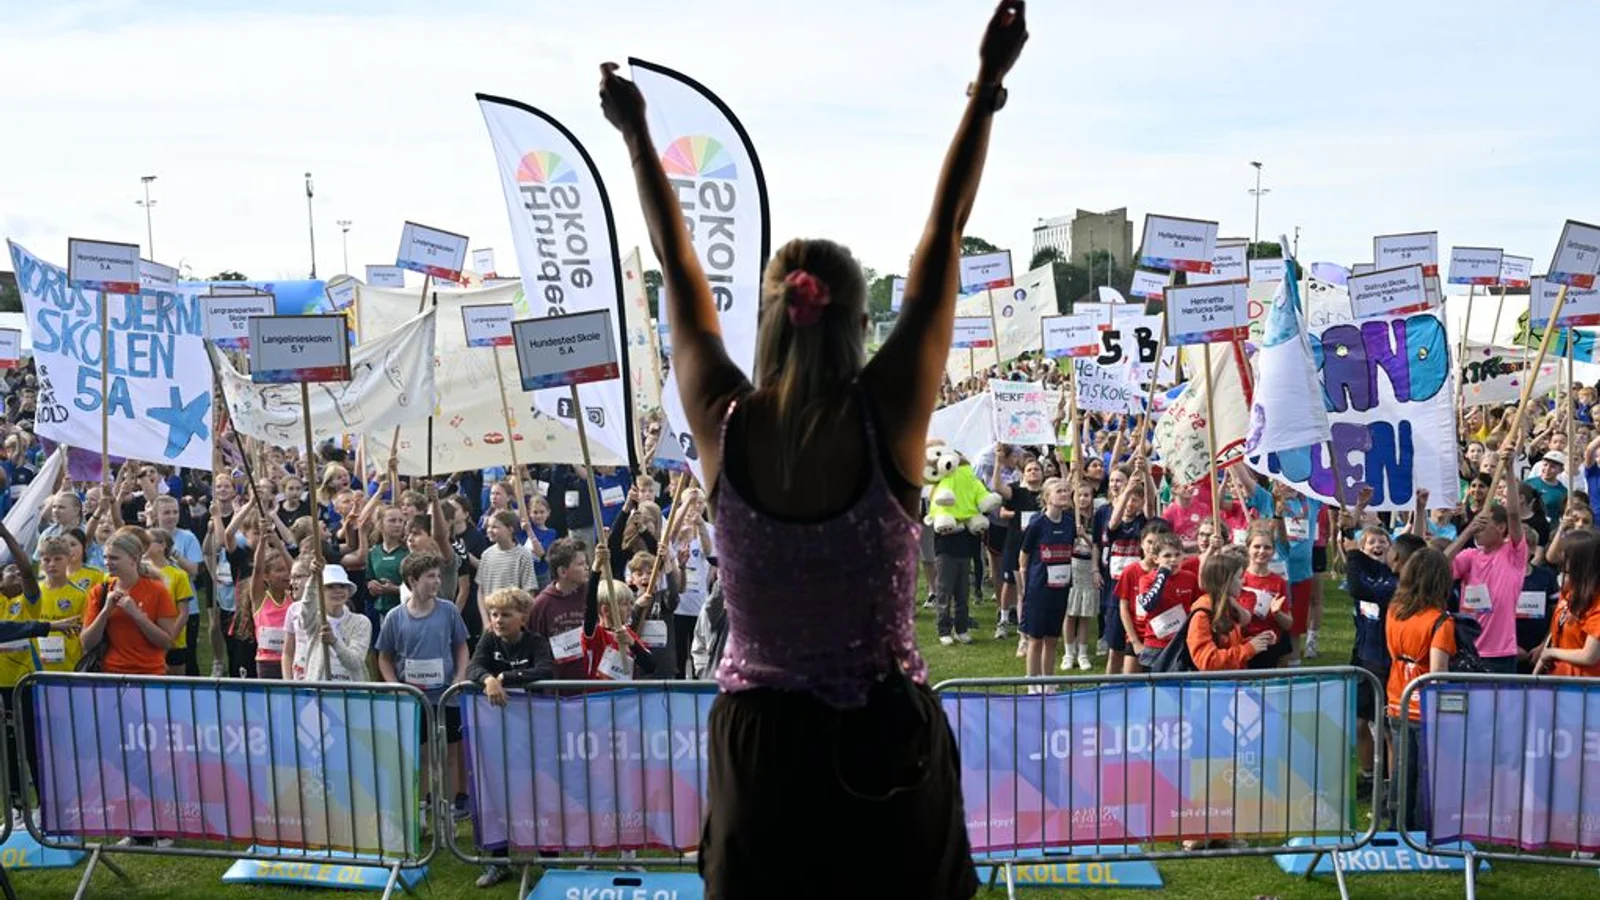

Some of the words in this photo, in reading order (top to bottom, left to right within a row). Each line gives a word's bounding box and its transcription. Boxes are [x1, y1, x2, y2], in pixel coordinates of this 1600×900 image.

[262, 334, 333, 347] Langelinieskolen
[529, 334, 577, 349] Hundested
[577, 332, 601, 343] Skole
[1087, 862, 1120, 884] OL
